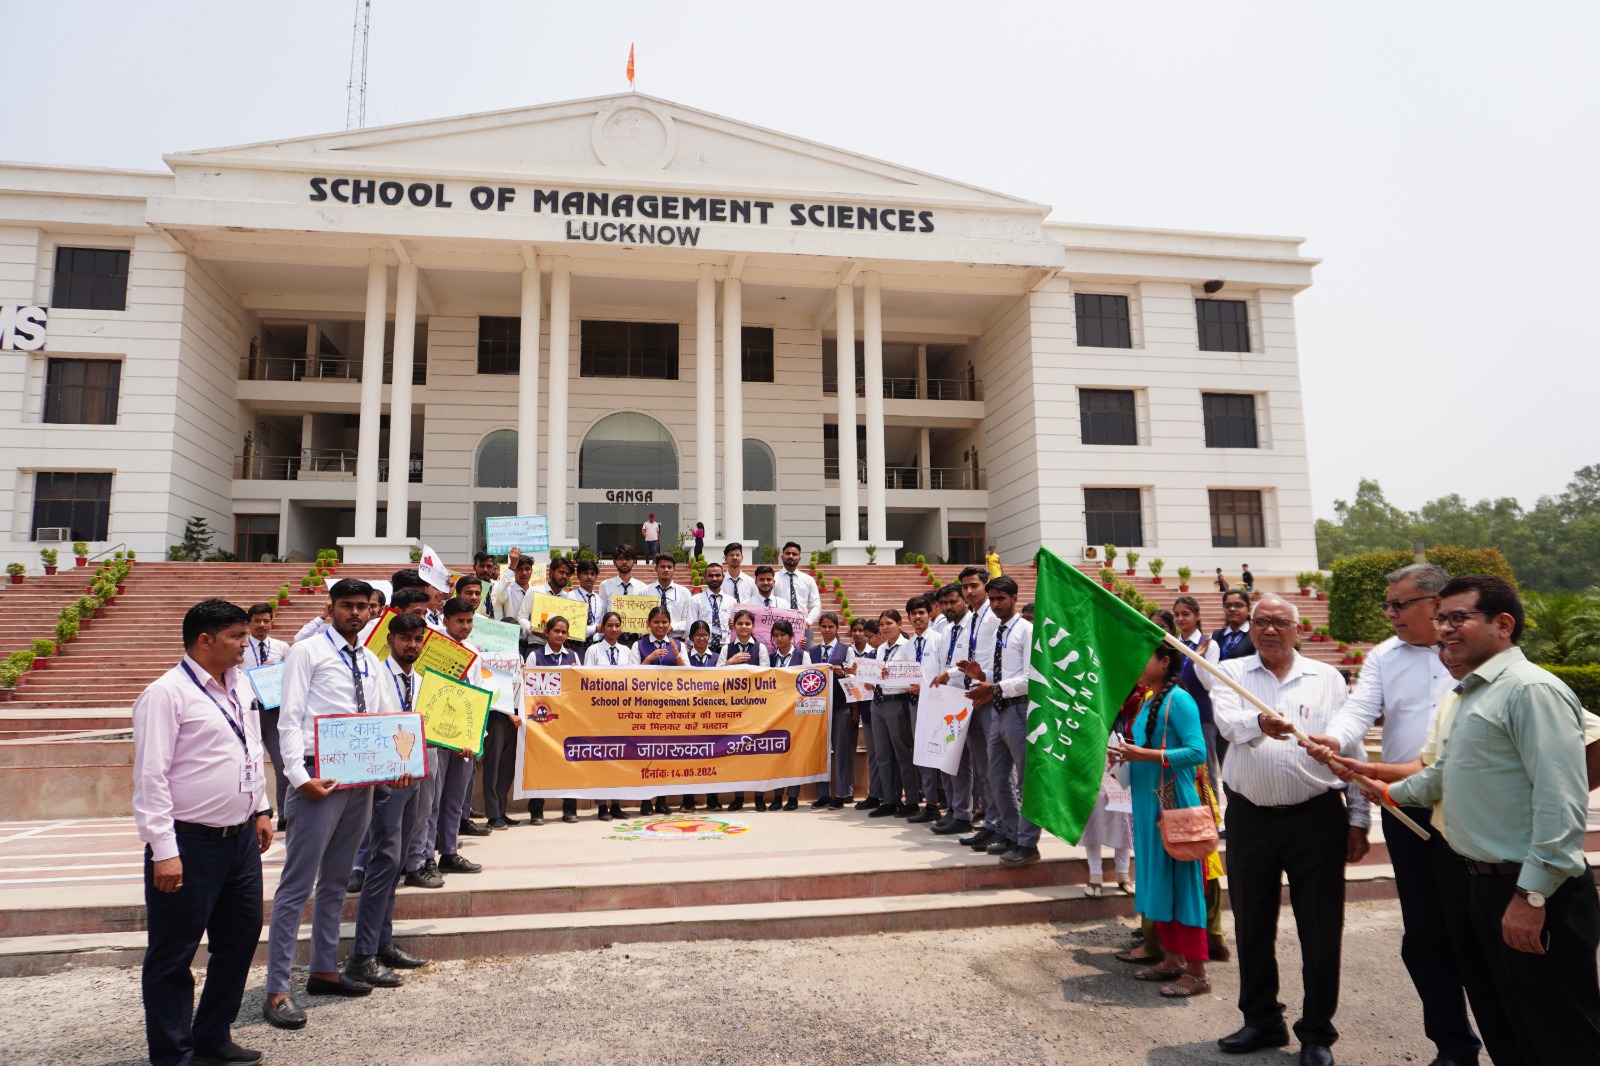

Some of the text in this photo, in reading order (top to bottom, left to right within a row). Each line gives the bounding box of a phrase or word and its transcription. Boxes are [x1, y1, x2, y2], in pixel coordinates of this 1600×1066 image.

[309, 177, 935, 233] SCHOOL OF MANAGEMENT SCIENCES
[566, 219, 701, 247] LUCKNOW
[605, 490, 653, 503] GANGA
[526, 673, 561, 691] SMS
[580, 677, 777, 694] National Service Scheme (NSS) Unit
[591, 696, 767, 709] School of Management Sciences, Lucknow
[1052, 654, 1101, 762] LUCKNOW
[617, 710, 742, 720] प्रत्येक वोट लोकतंत्र की पहचान
[631, 723, 646, 731] सब
[650, 722, 681, 731] मिलकर
[702, 722, 728, 730] मतदान
[567, 735, 788, 759] मतदाता जागरूकता अभियान
[671, 766, 718, 779] 14.05.2024
